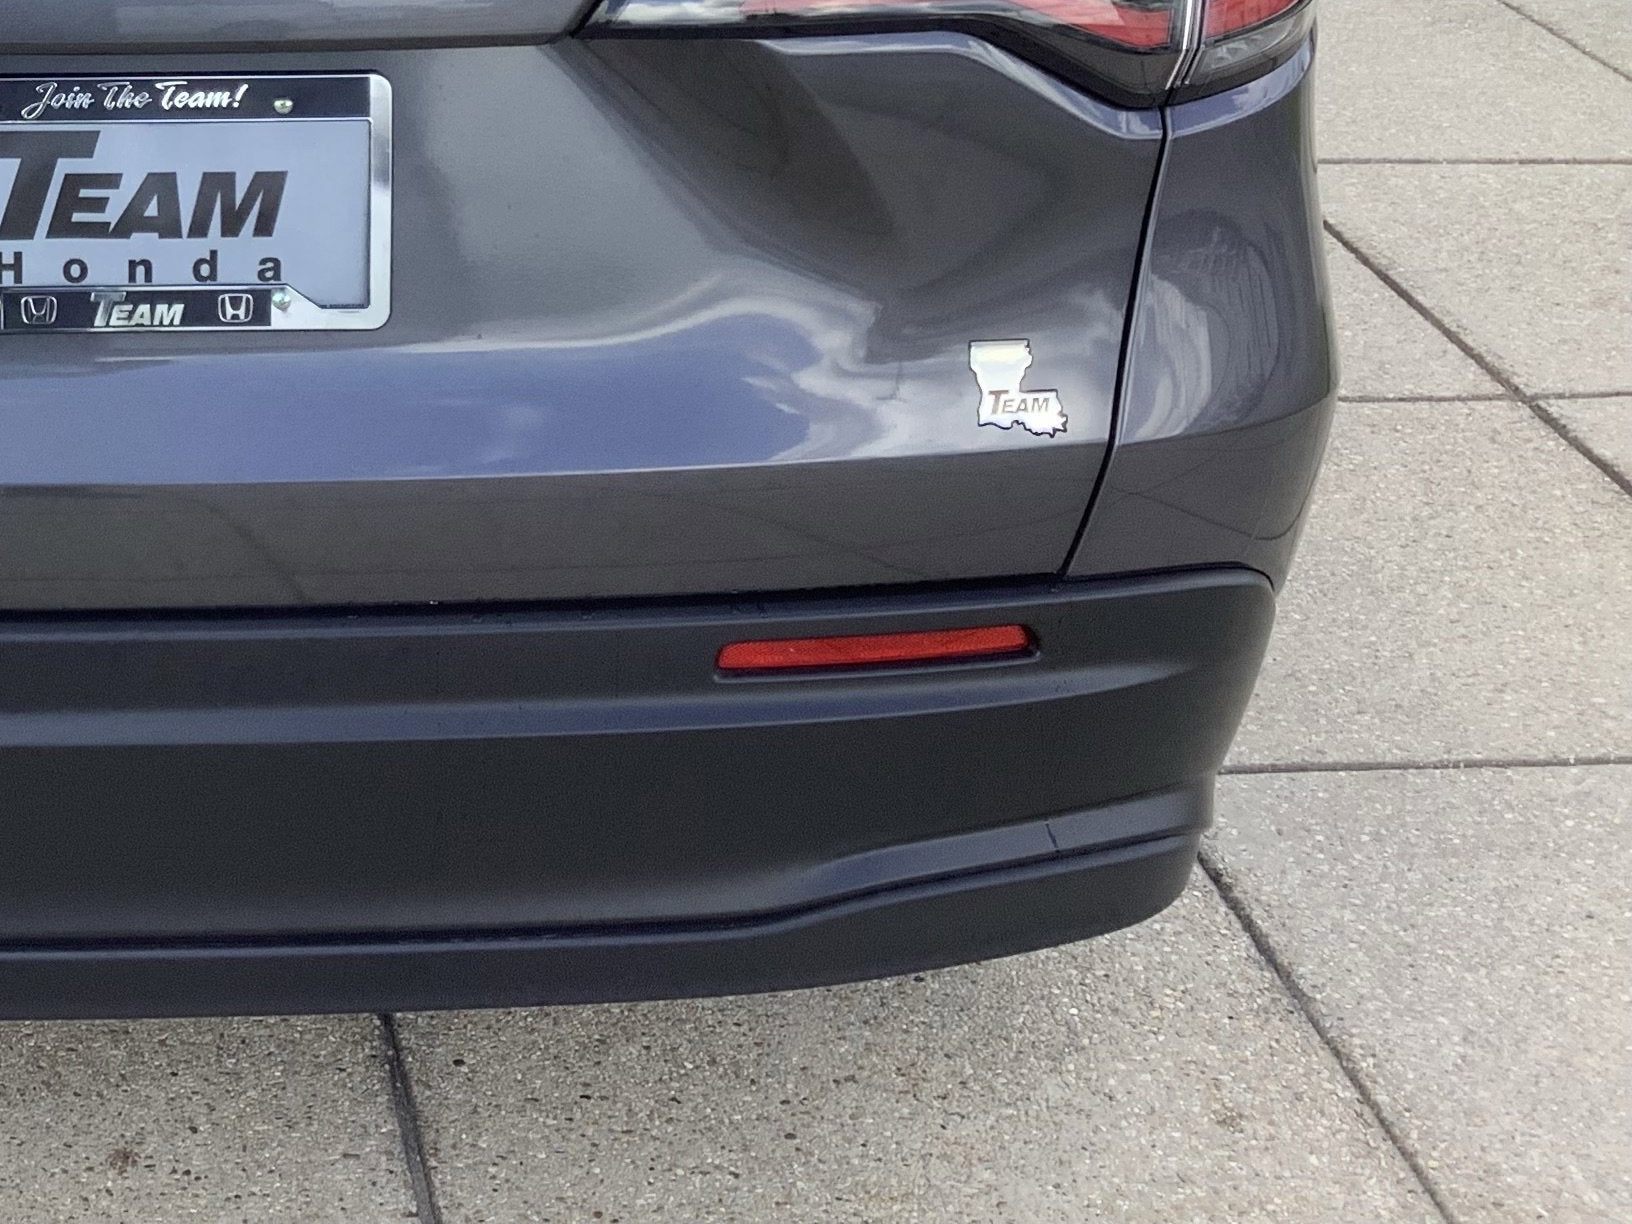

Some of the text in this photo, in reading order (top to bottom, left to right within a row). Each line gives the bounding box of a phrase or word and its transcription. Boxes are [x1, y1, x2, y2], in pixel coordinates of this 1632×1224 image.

[21, 81, 248, 119] Join The Team!
[90, 291, 184, 326] TEAM
[988, 389, 1050, 415] TEAM
